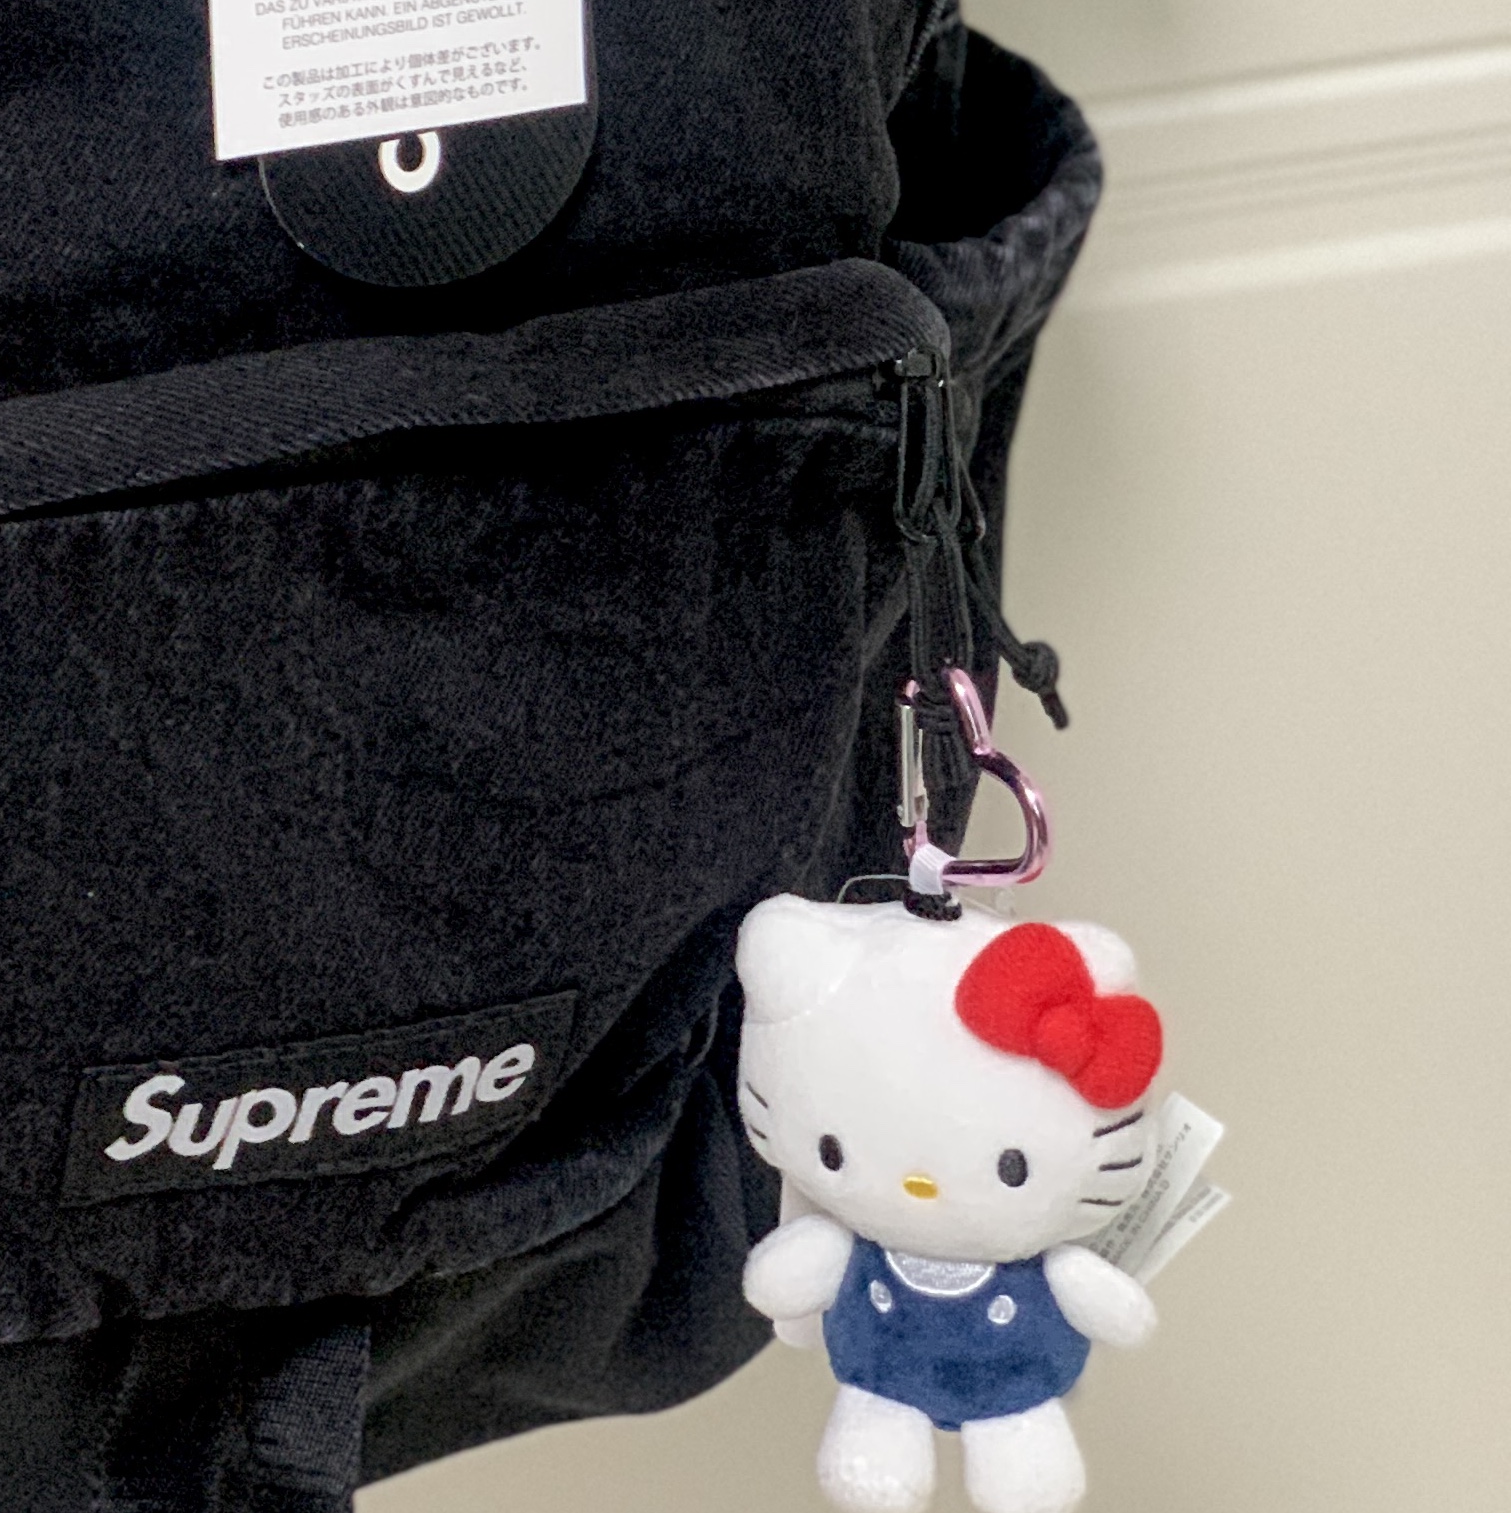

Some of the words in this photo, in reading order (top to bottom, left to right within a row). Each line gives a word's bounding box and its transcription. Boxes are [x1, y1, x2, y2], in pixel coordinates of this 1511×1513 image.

[255, 0, 285, 15] DAS
[393, 0, 417, 14] EIN
[282, 19, 428, 48] ERSCHEINUNGSBILD
[432, 12, 452, 27] IST
[104, 1044, 535, 1170] Supreme
